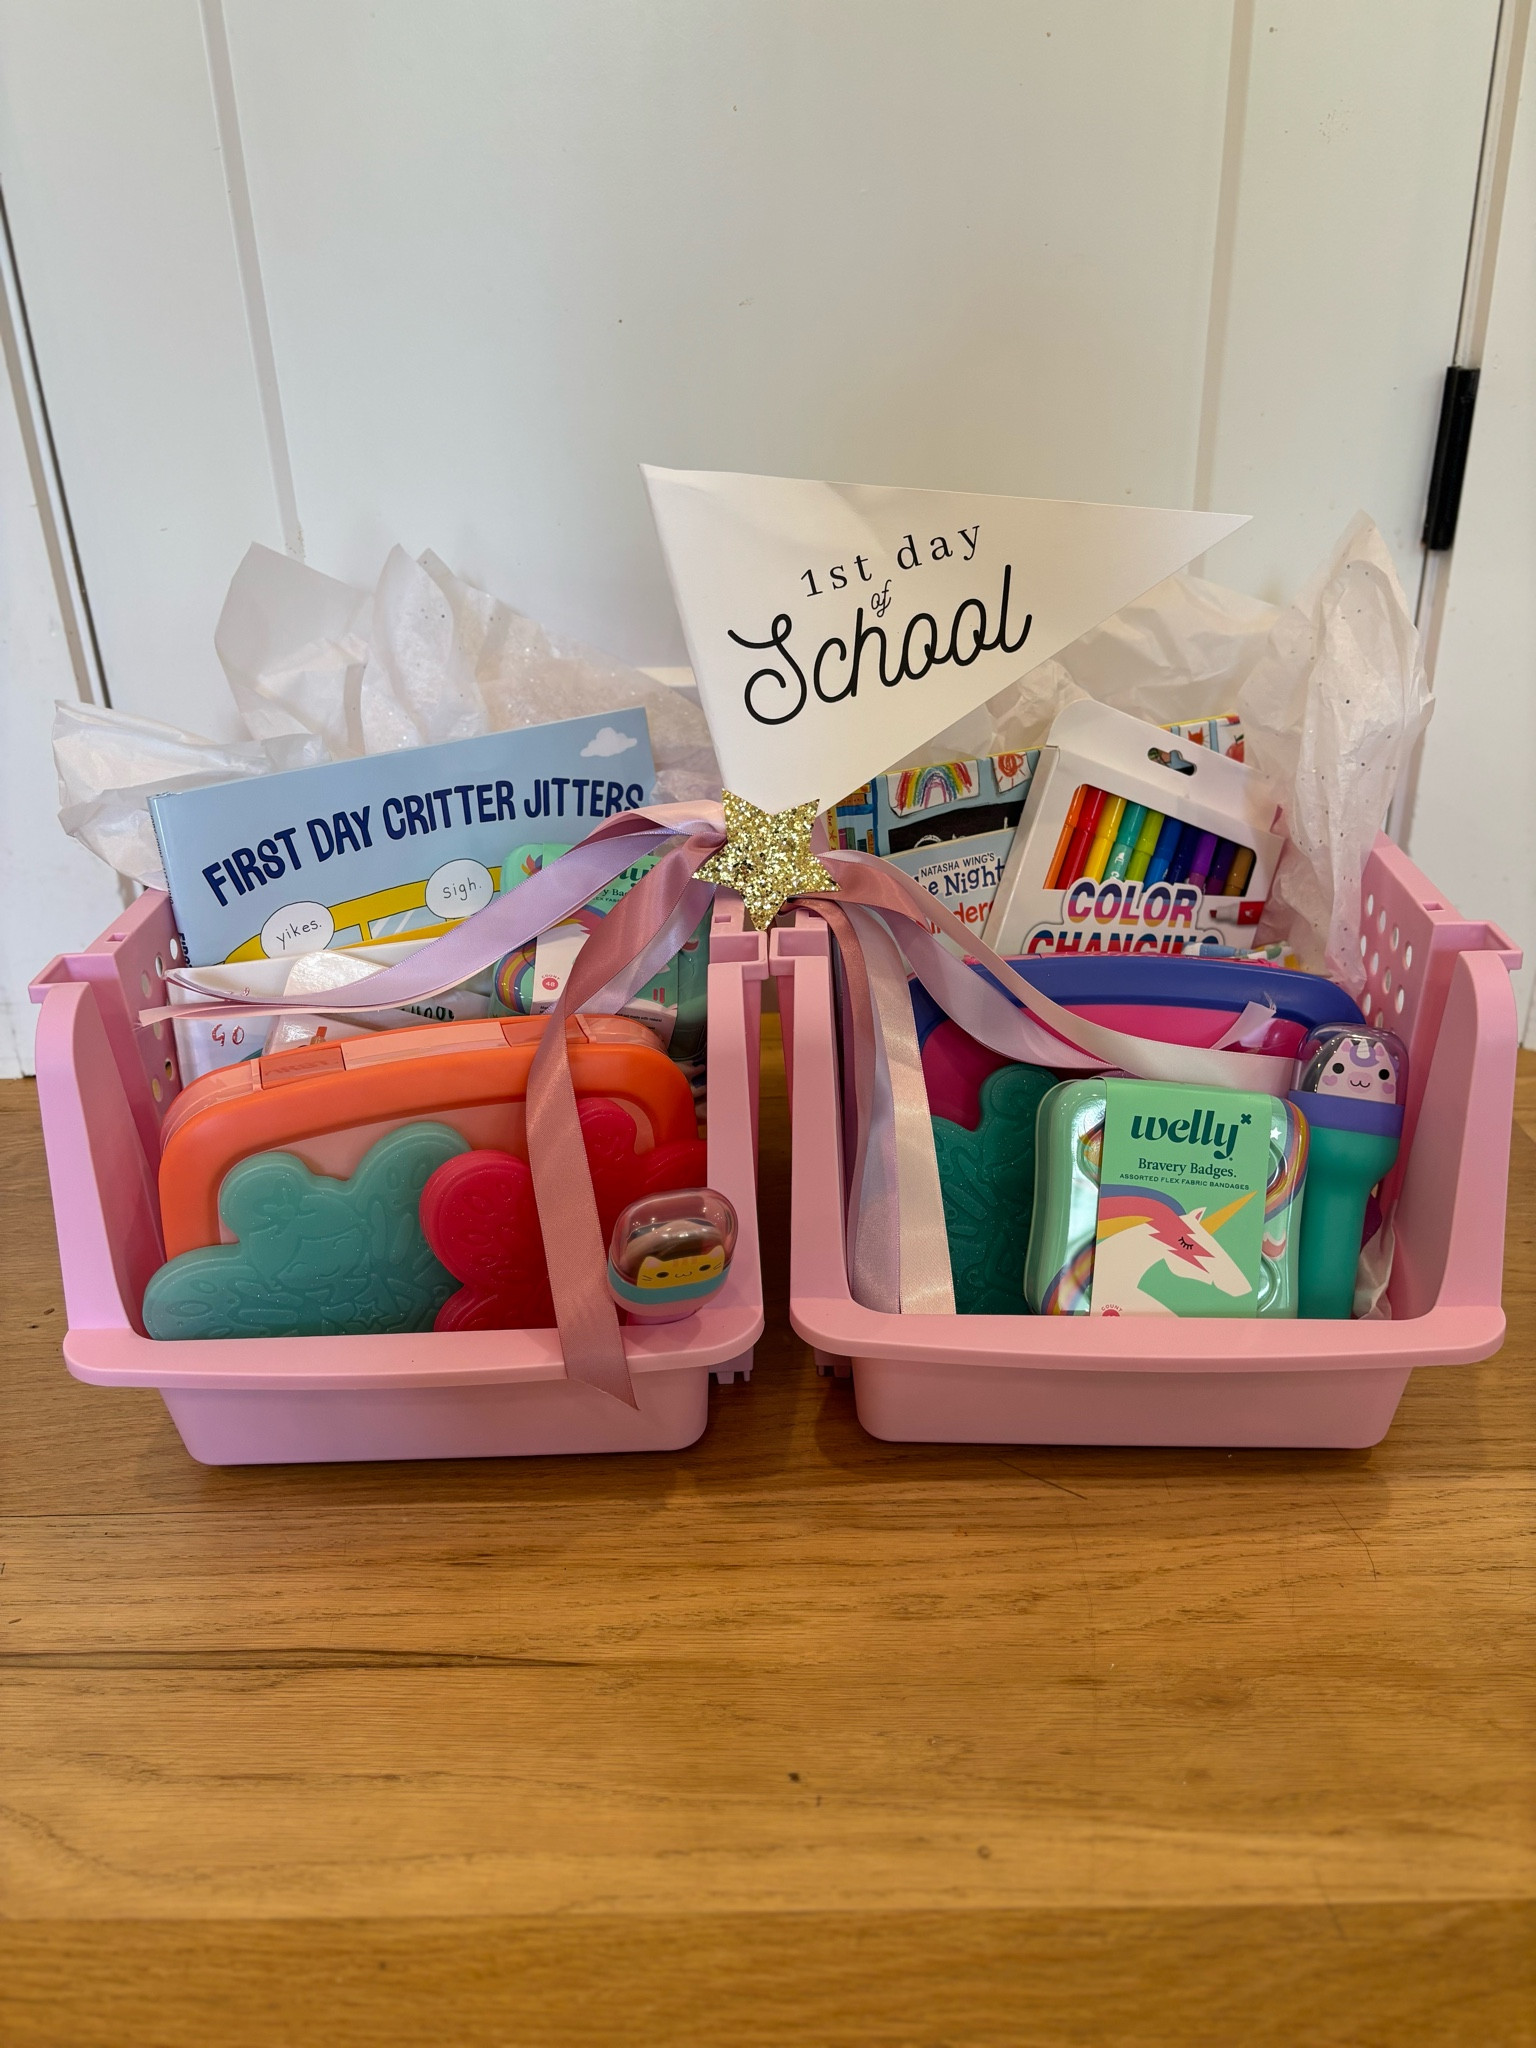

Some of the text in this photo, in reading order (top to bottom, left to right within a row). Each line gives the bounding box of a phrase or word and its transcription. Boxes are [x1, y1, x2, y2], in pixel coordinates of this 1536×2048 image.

[800, 524, 981, 598] 1st day
[870, 579, 893, 617] of
[727, 564, 1032, 726] School
[201, 827, 303, 907] FIRST
[307, 805, 374, 862] DAY
[382, 780, 516, 836] CRITTER
[523, 777, 645, 819] JITTERS
[920, 853, 996, 877] NATASHA WING'S
[944, 858, 1006, 897] Night
[442, 876, 483, 902] sigh.
[1067, 881, 1198, 928] COLOR
[276, 918, 324, 953] yikes.
[1131, 1109, 1239, 1160] welly
[1120, 1173, 1159, 1182] ASSORTED
[1181, 1179, 1208, 1187] FABRIC
[1209, 1181, 1250, 1190] BANDAGES
[1138, 1158, 1237, 1179] Bravery Badges.
[1101, 1304, 1123, 1312] COUNT
